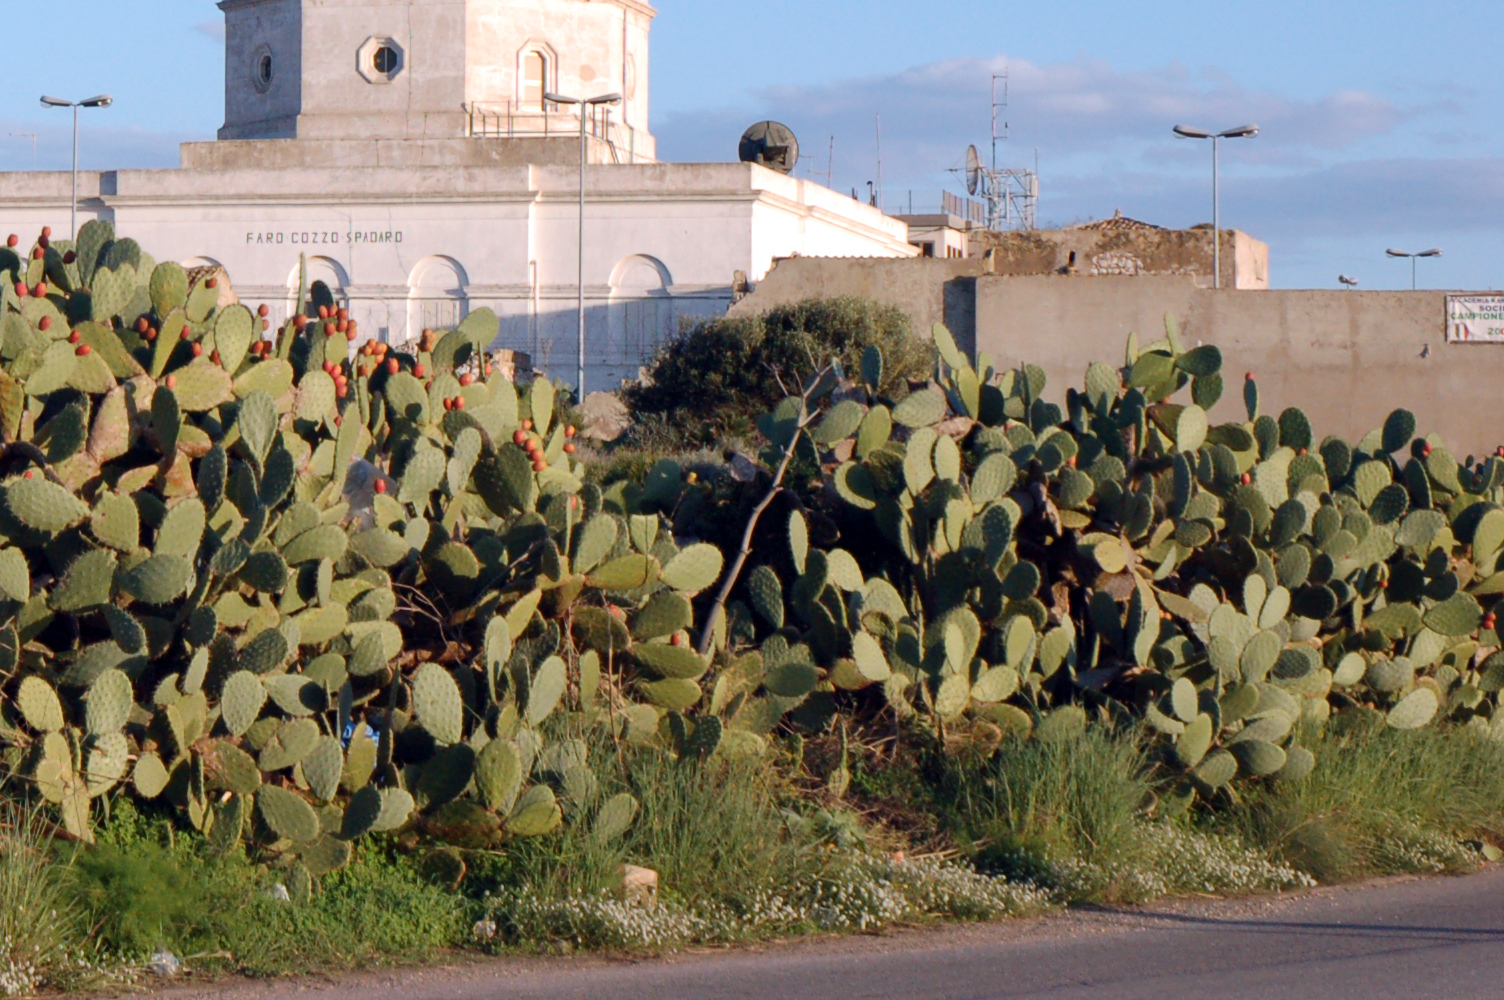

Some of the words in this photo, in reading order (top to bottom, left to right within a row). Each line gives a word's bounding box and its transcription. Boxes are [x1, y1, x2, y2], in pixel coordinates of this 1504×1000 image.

[246, 232, 283, 244] FARO
[291, 232, 339, 244] COZZO
[346, 231, 403, 243] SPADARO
